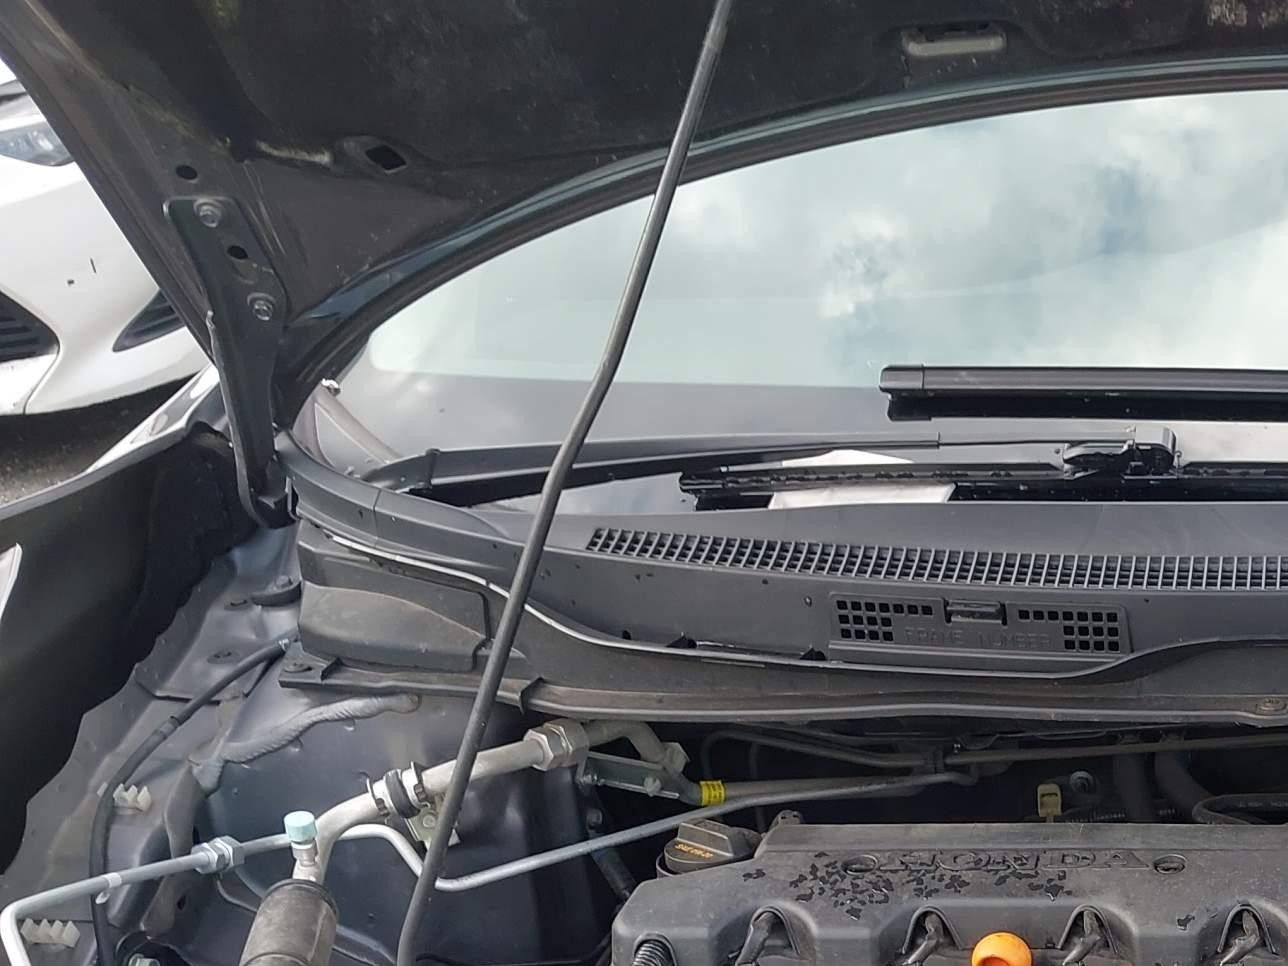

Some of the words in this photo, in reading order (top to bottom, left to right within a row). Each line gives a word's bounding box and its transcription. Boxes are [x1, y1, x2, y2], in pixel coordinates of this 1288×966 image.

[904, 627, 964, 645] FRAME
[976, 631, 1052, 649] NUMBER
[879, 850, 1150, 871] HONDA
